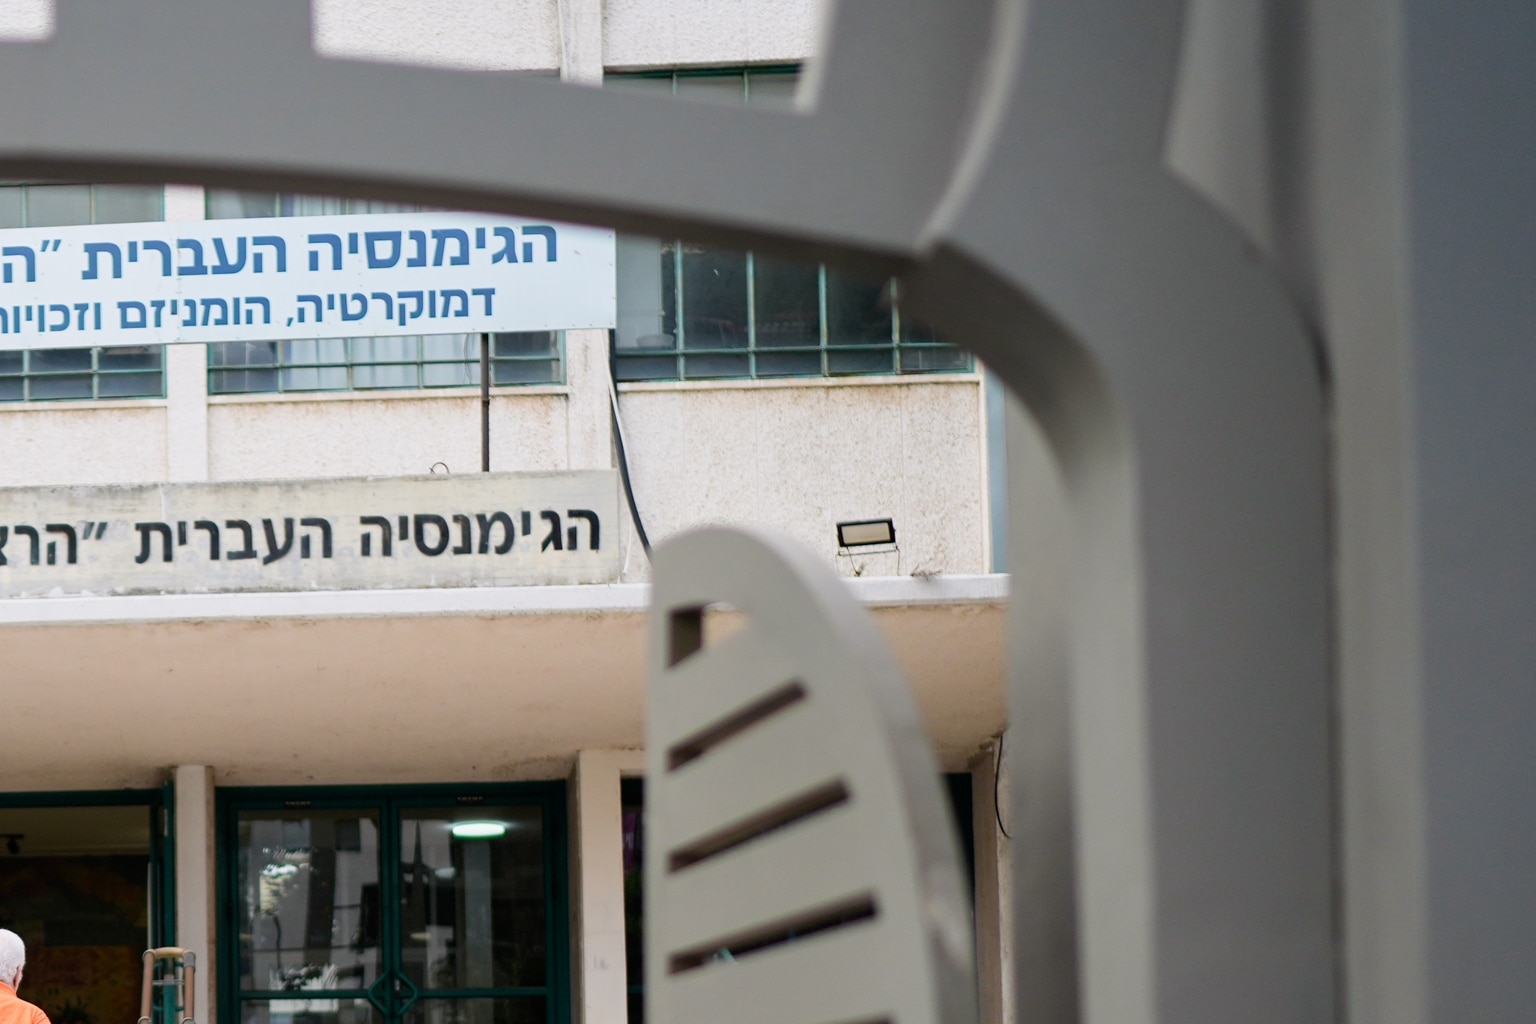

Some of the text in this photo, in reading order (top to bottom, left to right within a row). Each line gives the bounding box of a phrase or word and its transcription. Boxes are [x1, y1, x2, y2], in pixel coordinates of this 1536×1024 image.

[81, 235, 287, 280] העברית
[307, 224, 558, 272] הגימנסיה
[117, 296, 271, 329] הומניזם
[286, 287, 496, 327] דמוקרטיה,
[134, 516, 332, 566] העברית
[359, 508, 600, 557] הגימנסיה
